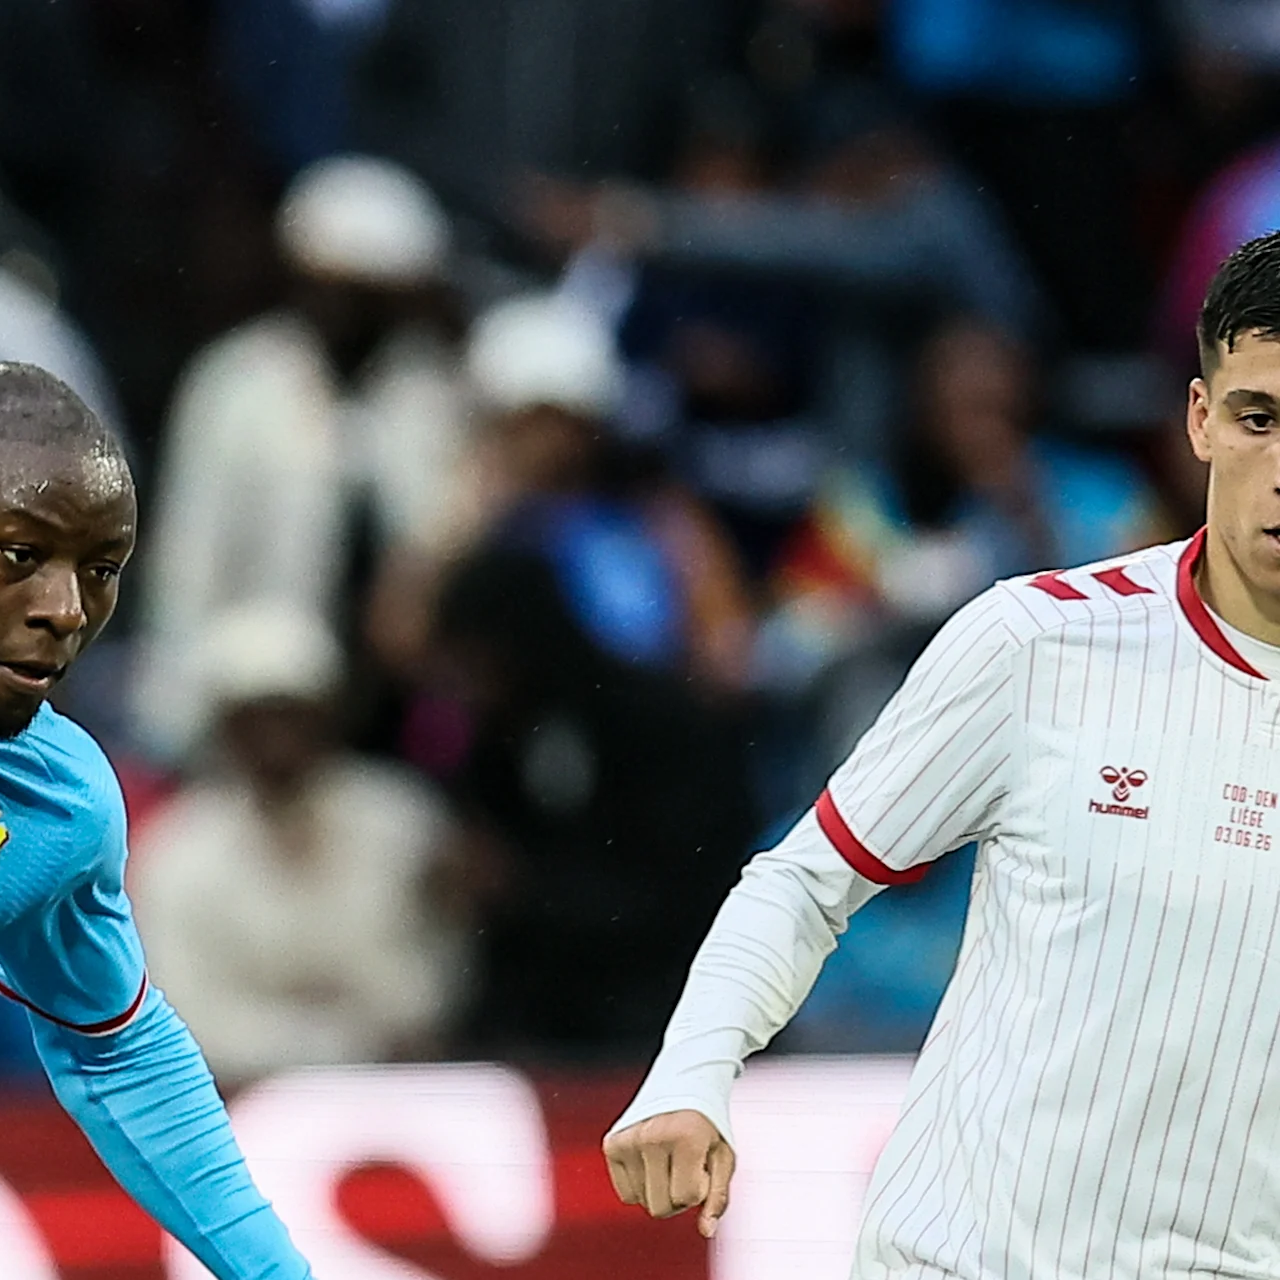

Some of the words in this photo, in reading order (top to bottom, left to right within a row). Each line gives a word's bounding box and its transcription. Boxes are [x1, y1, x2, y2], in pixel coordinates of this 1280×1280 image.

[1088, 797, 1150, 820] hummel
[1230, 806, 1265, 829] LIÈGE
[1214, 826, 1272, 851] 03.06.26
